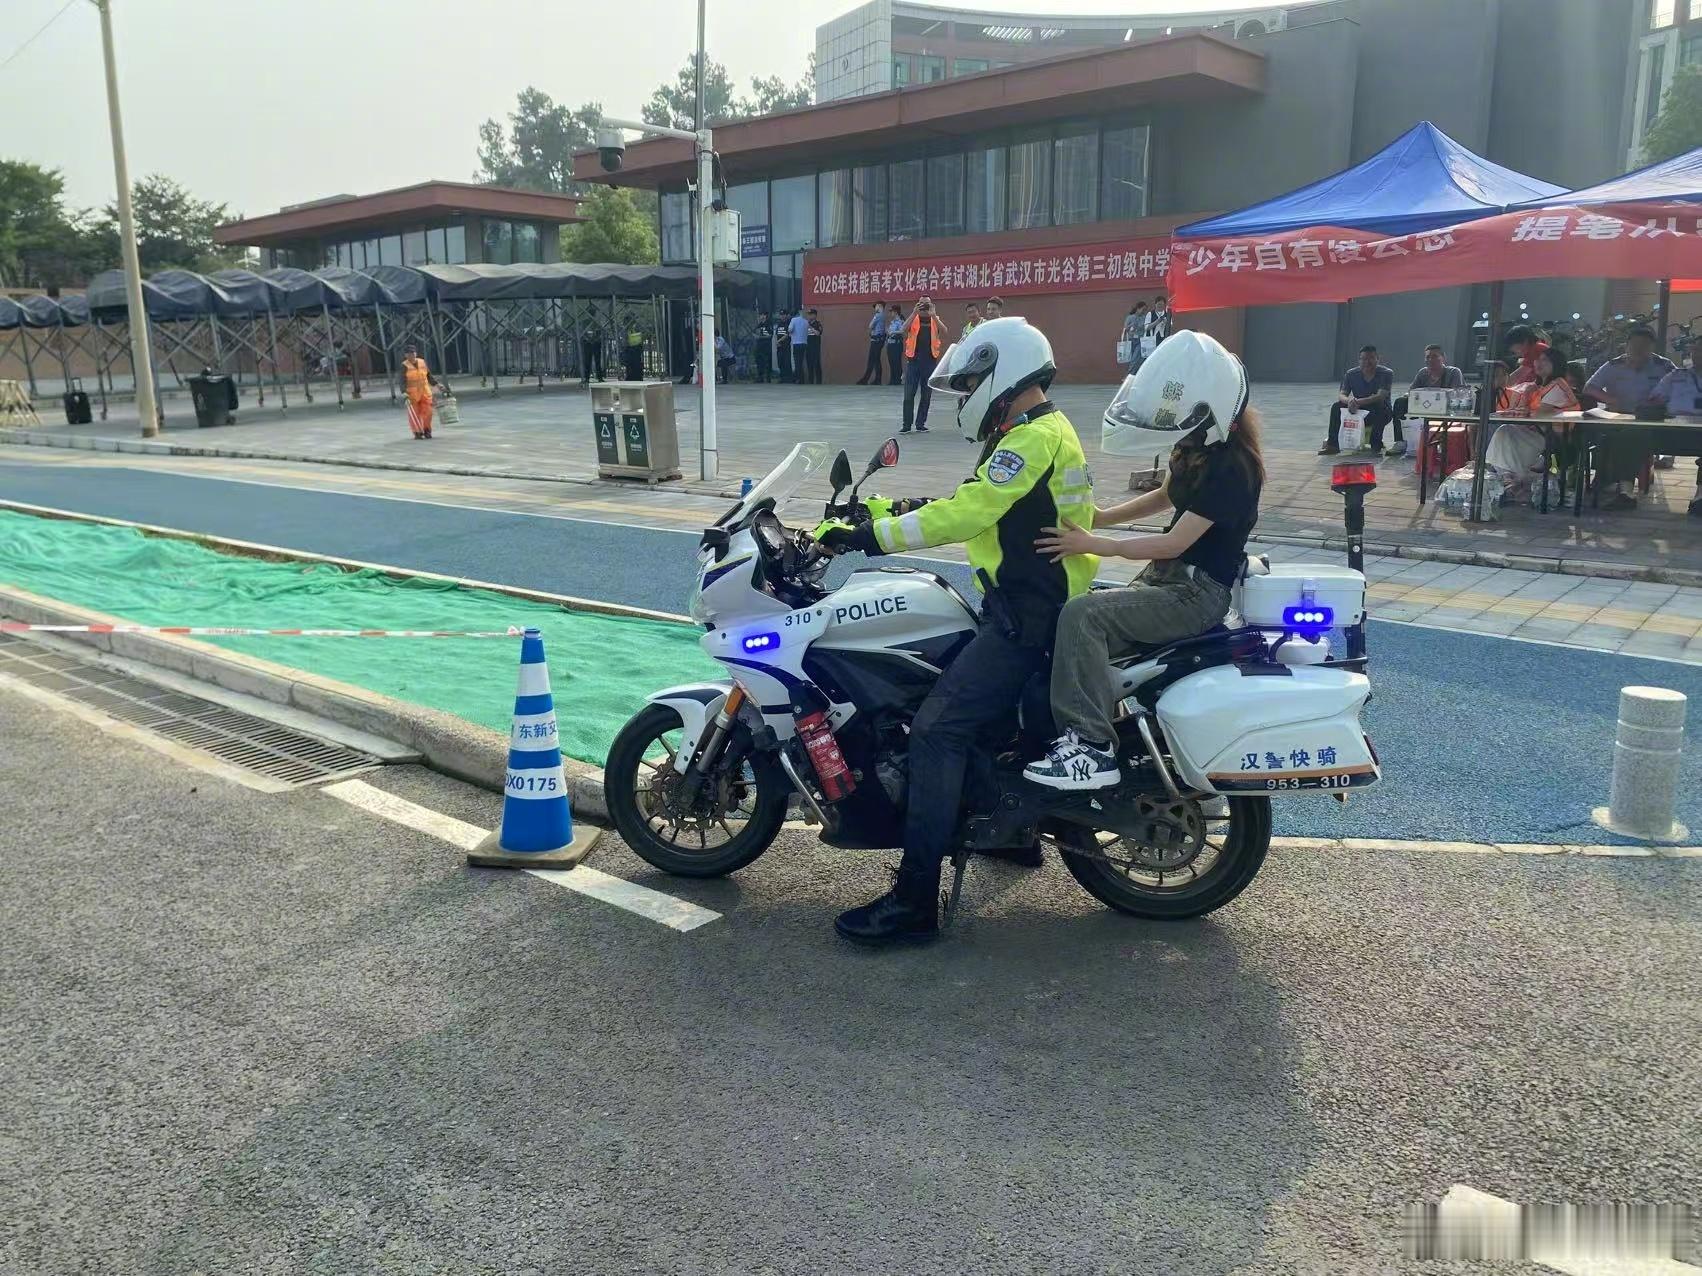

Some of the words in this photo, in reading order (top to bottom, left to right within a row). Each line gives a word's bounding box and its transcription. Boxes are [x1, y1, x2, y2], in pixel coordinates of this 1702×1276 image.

[1511, 214, 1702, 241] 提笔从
[785, 612, 811, 627] 310
[836, 596, 907, 624] POLICE
[1240, 747, 1337, 770] 汉警快骑
[1071, 759, 1092, 782] NY
